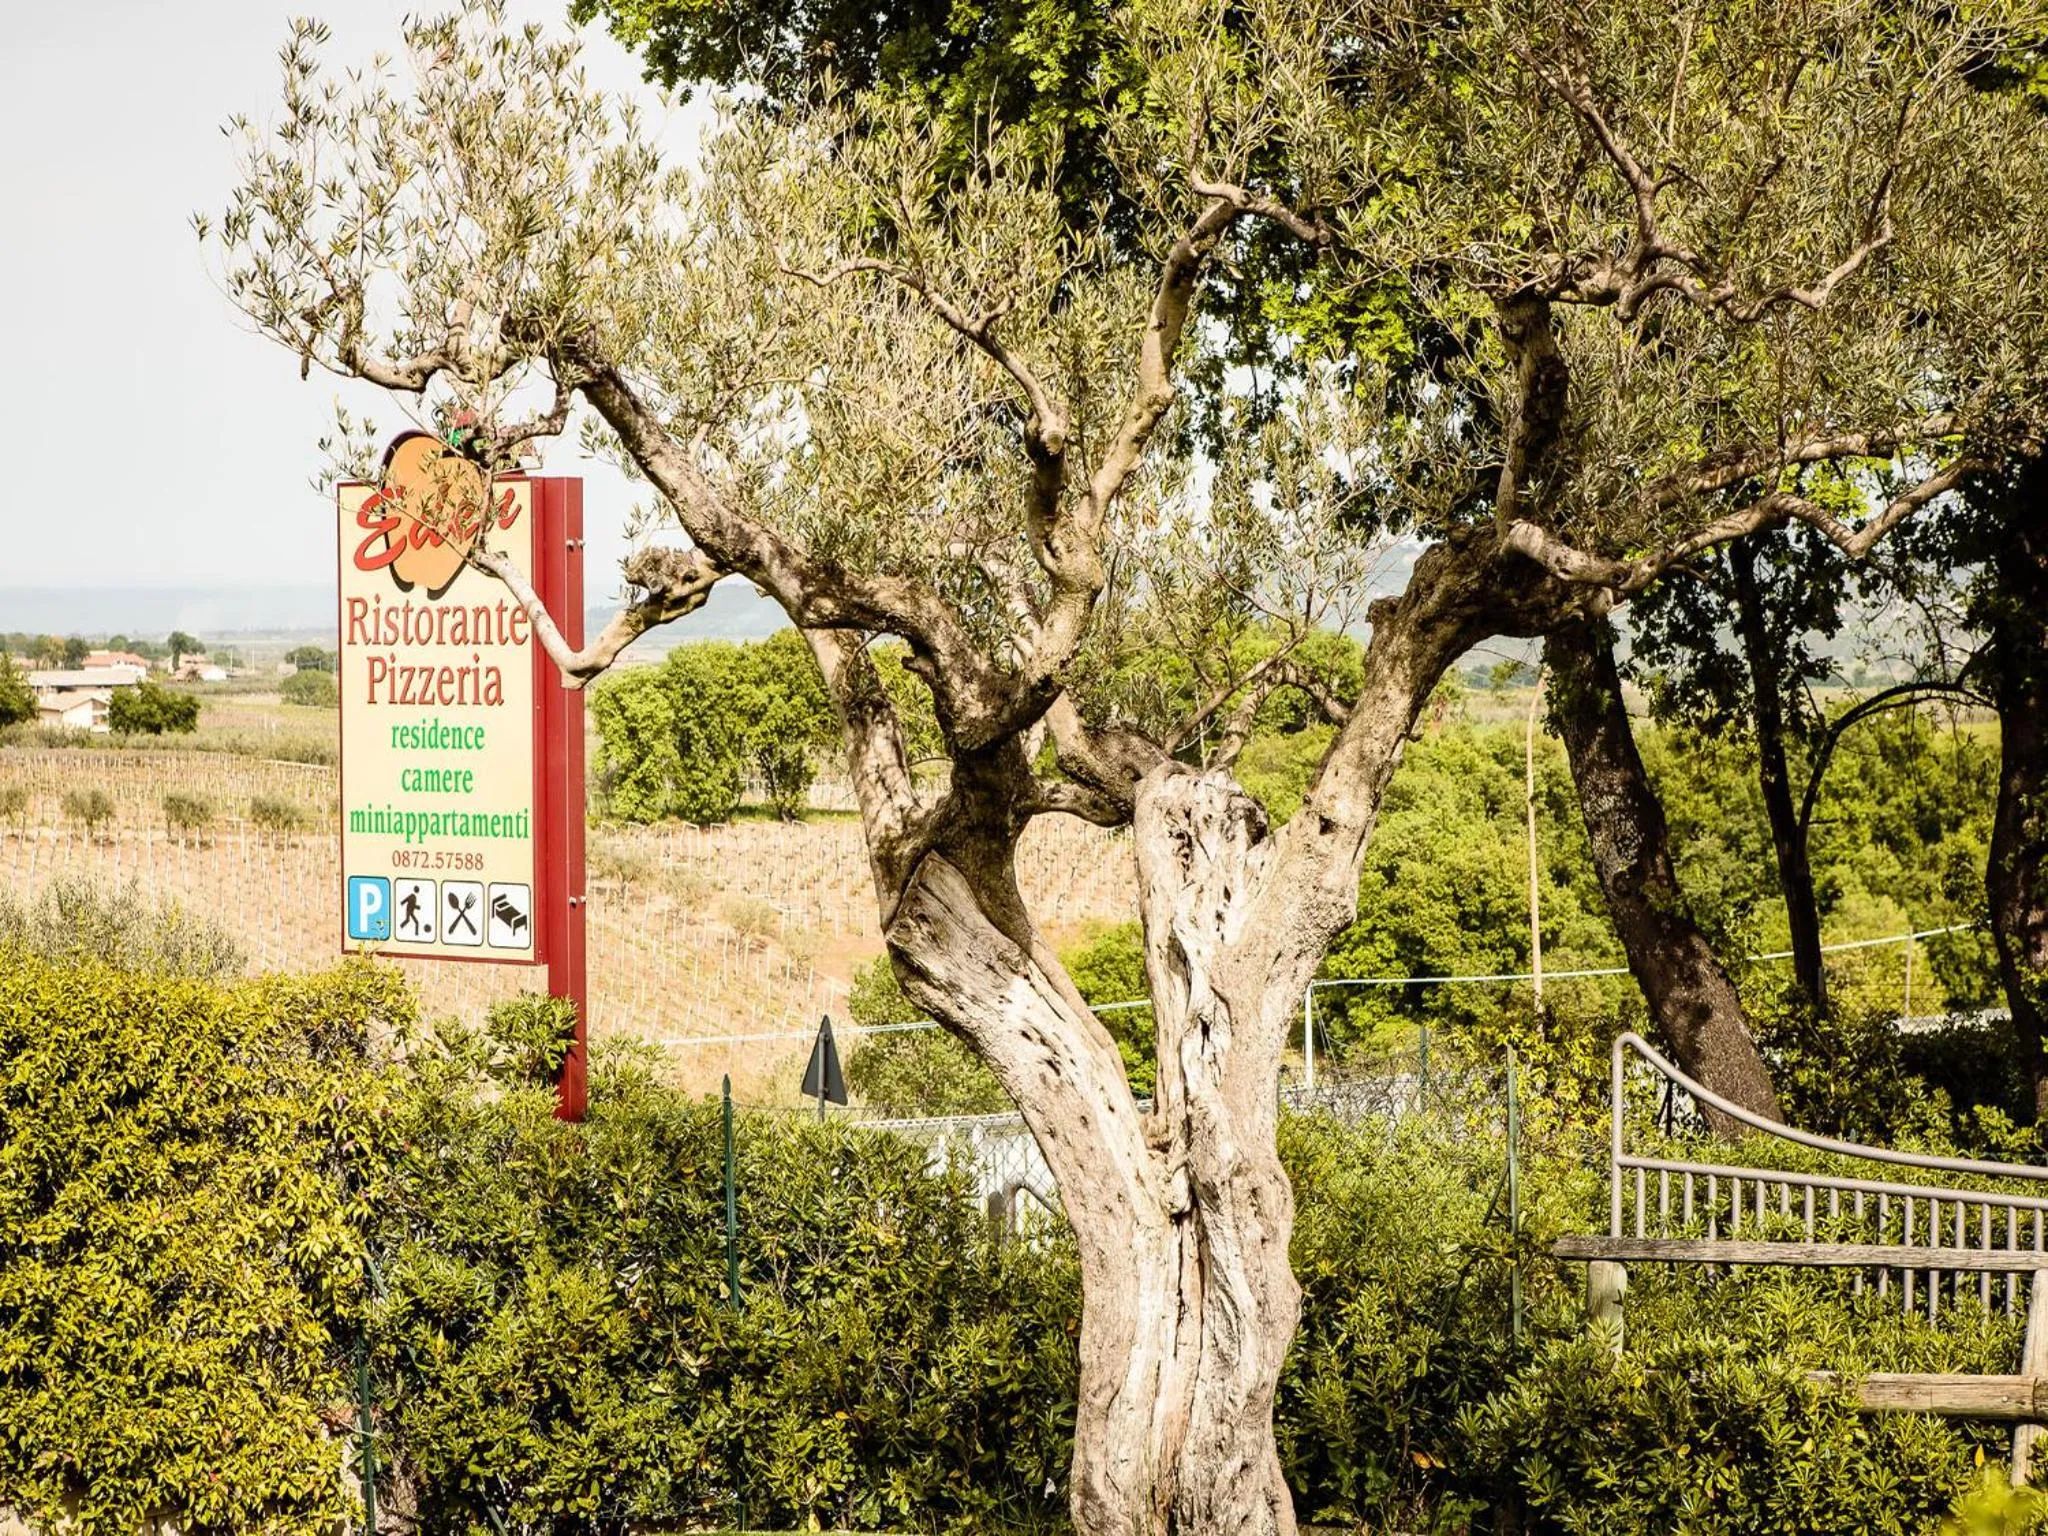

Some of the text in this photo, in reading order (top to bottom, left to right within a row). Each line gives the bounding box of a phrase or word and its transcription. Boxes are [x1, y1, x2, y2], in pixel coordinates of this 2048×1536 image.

[346, 593, 529, 646] Ristorante
[366, 652, 505, 706] Pizzeria
[391, 717, 485, 750] residence
[401, 768, 473, 793] camere
[350, 803, 529, 844] miniappartamenti
[391, 849, 484, 870] 0872.57588
[359, 882, 383, 933] P
